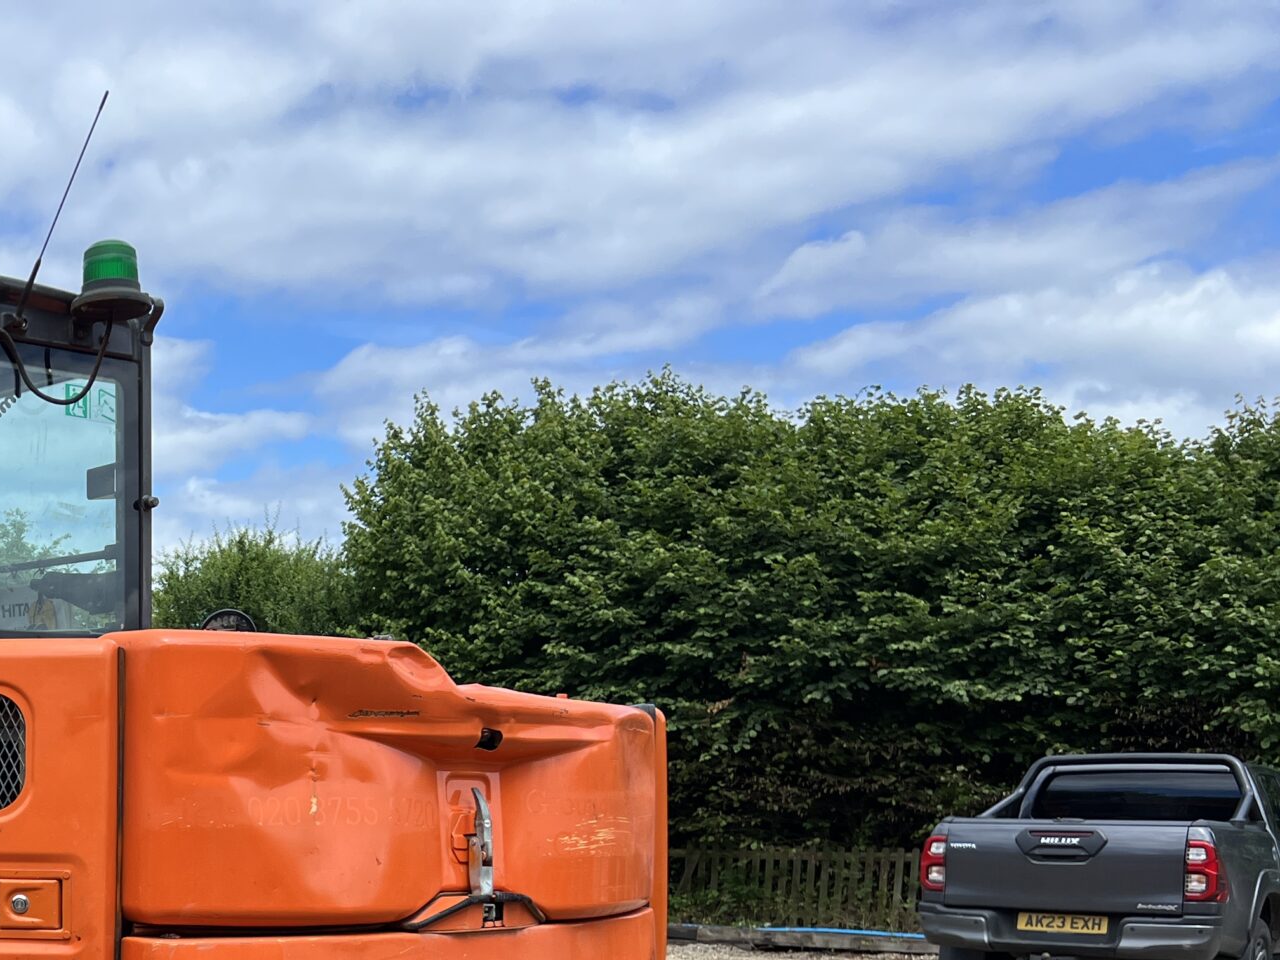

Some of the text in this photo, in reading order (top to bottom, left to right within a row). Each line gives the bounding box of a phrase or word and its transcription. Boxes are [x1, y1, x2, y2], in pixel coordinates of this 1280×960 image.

[1, 602, 31, 618] HITA
[1040, 837, 1080, 845] HILUX
[1024, 916, 1103, 931] AK23 EXH
